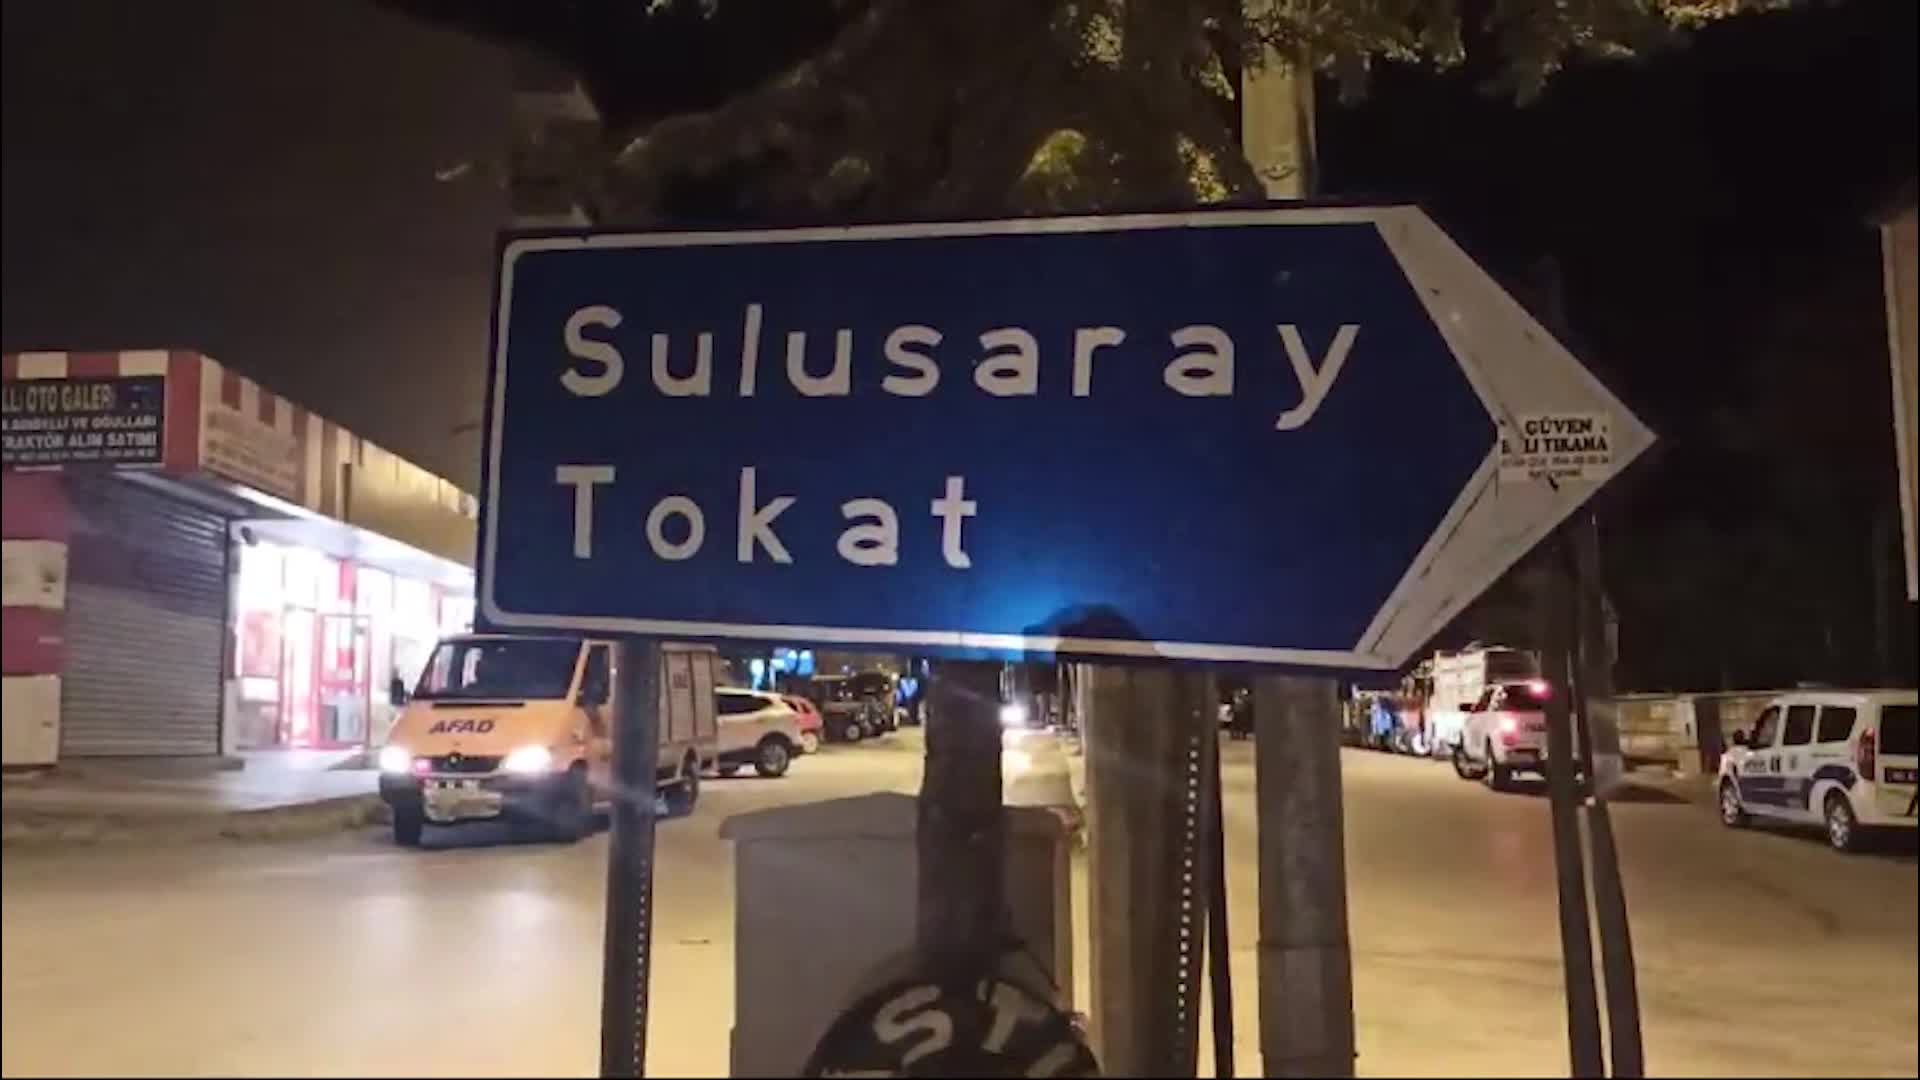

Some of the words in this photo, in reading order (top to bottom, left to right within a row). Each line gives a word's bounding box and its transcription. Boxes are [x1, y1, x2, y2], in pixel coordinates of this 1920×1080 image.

[561, 304, 1359, 430] Sulusaray
[26, 385, 58, 413] OTO
[1525, 416, 1593, 435] GÜVEN
[556, 465, 977, 569] Tokat
[428, 719, 496, 734] AFAD
